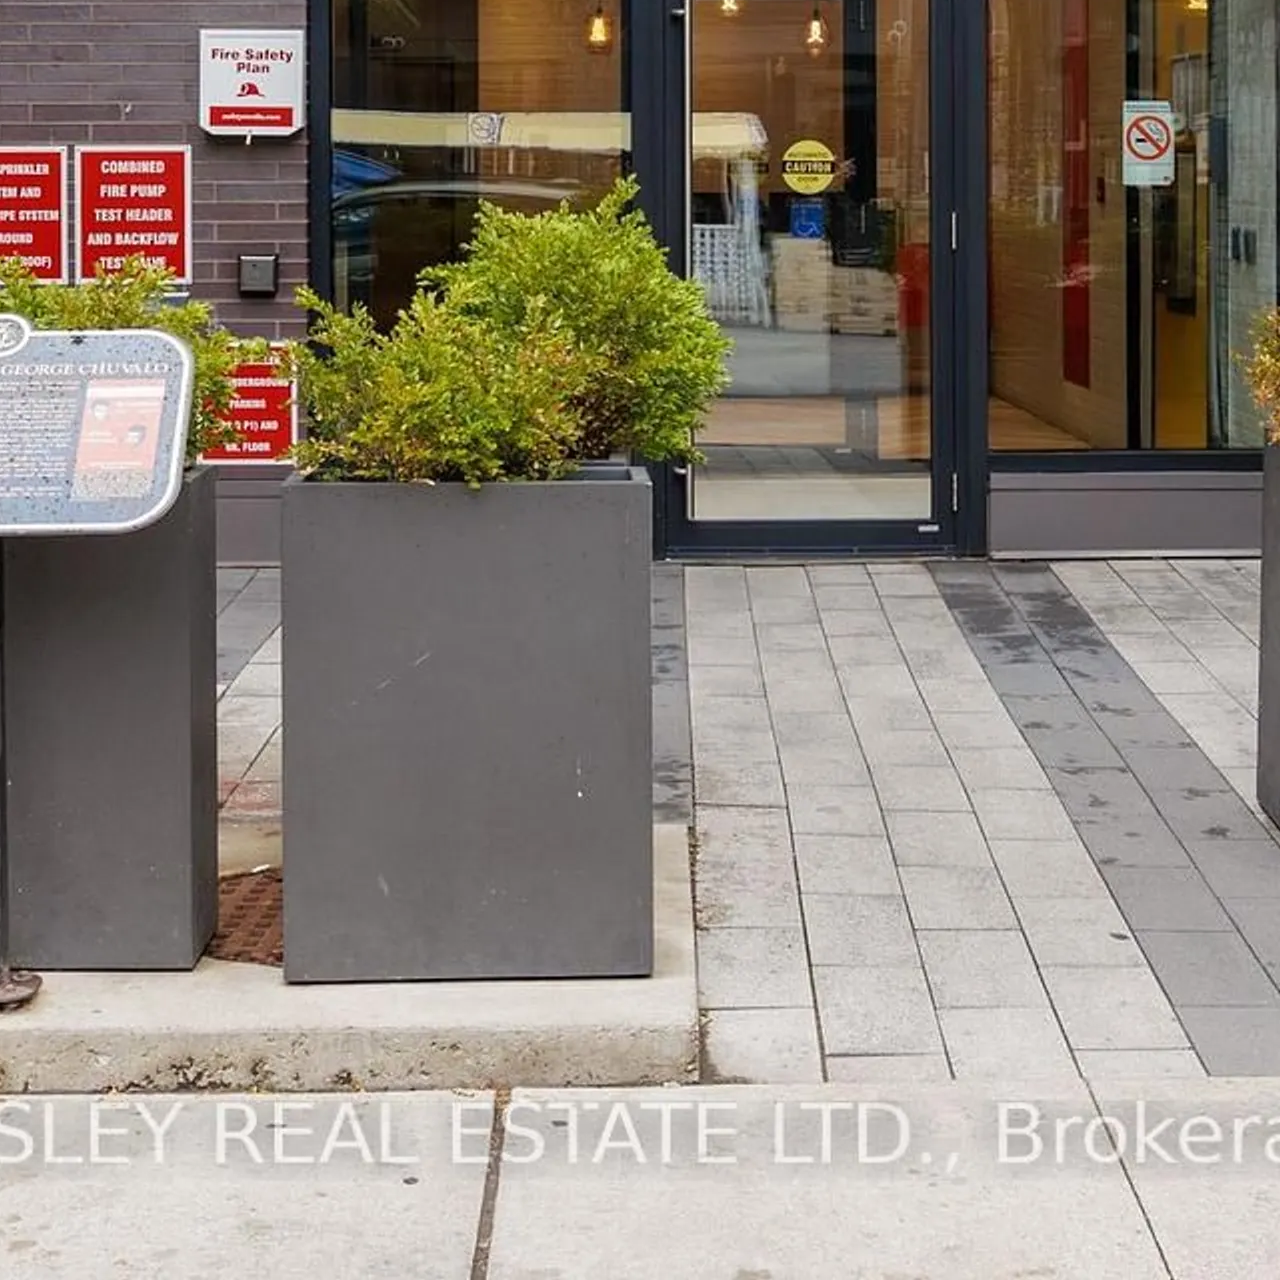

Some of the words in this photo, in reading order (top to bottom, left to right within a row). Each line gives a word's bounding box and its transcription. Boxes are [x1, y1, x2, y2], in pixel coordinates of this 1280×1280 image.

[211, 48, 240, 60] Fire
[245, 48, 293, 63] Safety
[236, 62, 270, 73] Plan
[100, 160, 165, 174] COMBINED
[785, 162, 831, 172] CAUTION
[20, 187, 41, 198] AND
[100, 185, 127, 197] FIRE
[130, 185, 167, 197] PUMP
[18, 209, 59, 221] SYSTEM
[95, 209, 122, 221] TEST
[125, 209, 173, 221] HEADER
[87, 233, 113, 245] AND
[115, 233, 179, 245] BACKFLOW
[0, 363, 75, 376] GEORGE
[77, 361, 169, 375] CHUVALO
